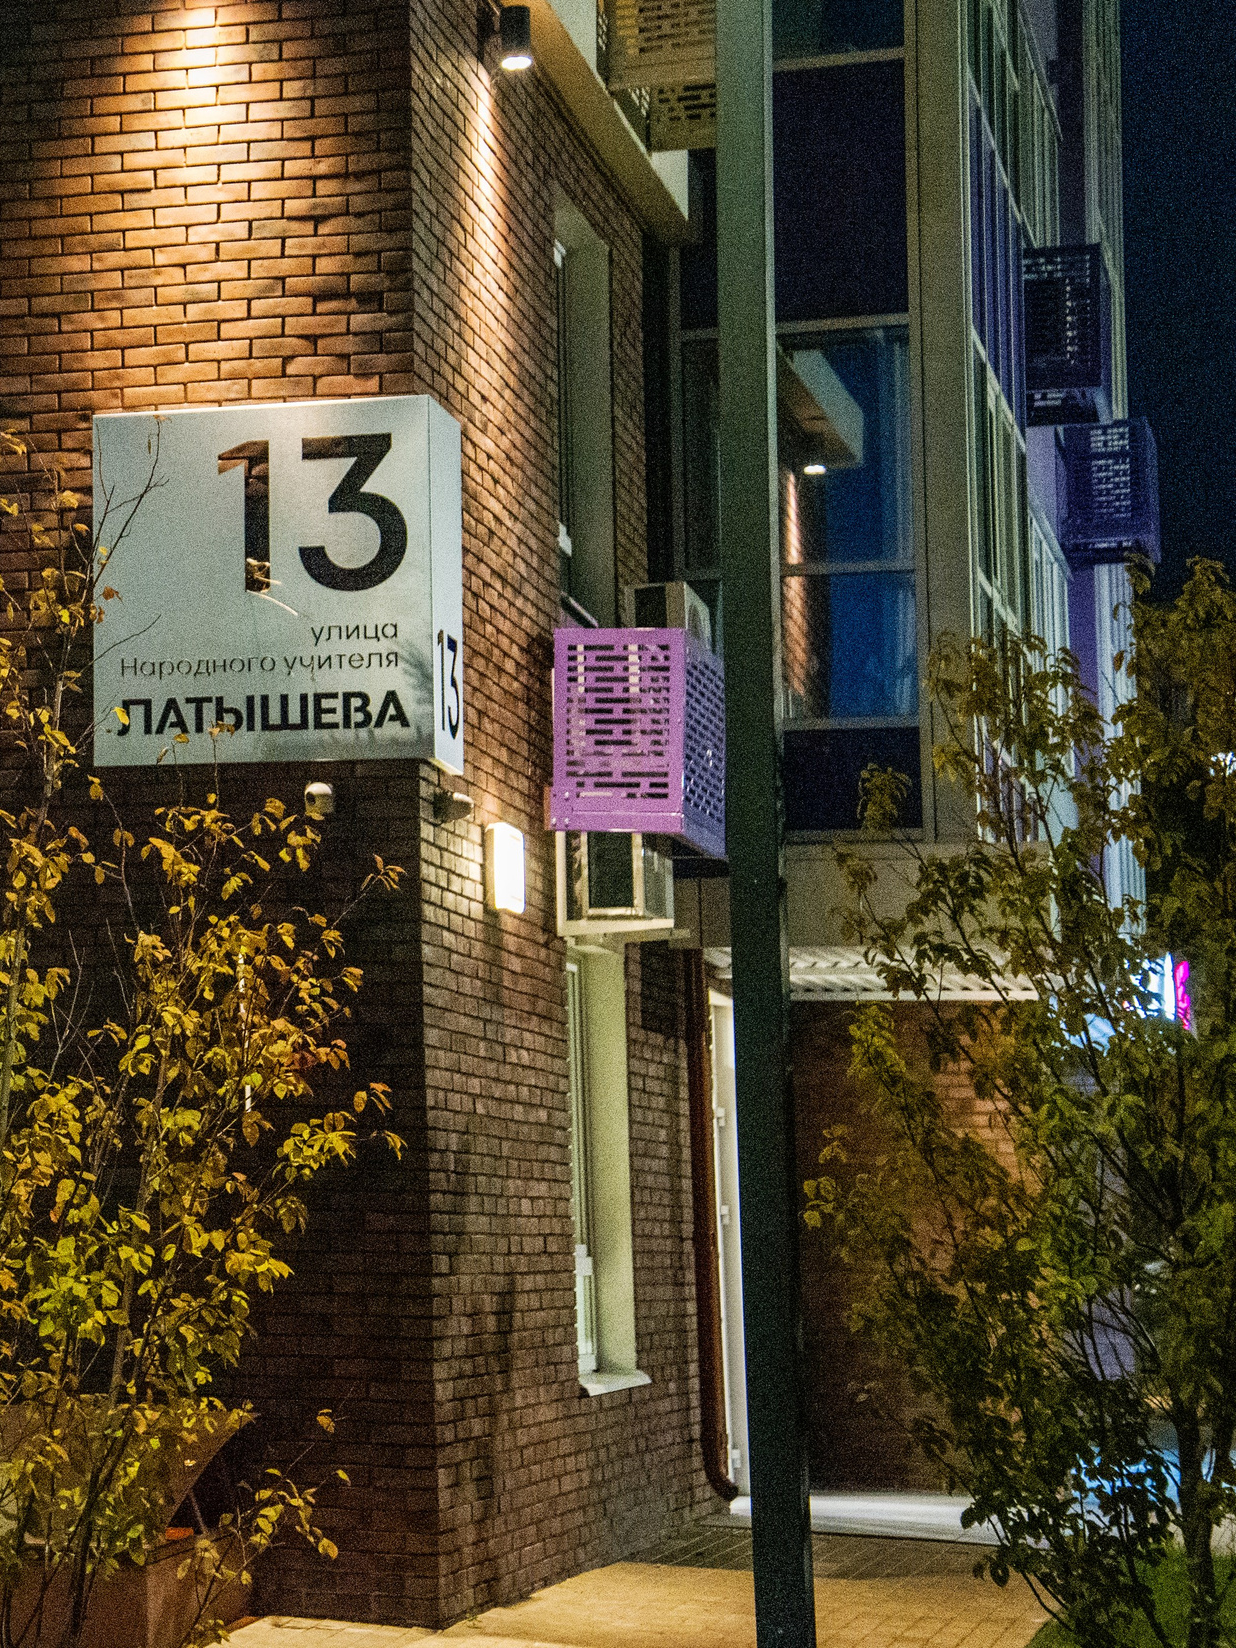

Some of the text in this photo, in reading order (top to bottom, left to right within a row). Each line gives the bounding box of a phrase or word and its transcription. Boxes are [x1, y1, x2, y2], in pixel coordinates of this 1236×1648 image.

[217, 432, 409, 593] 13
[310, 621, 399, 647] улица
[120, 650, 400, 681] Народного учителя
[437, 628, 460, 740] 13
[116, 689, 411, 737] ЛАТЫШЕВА
